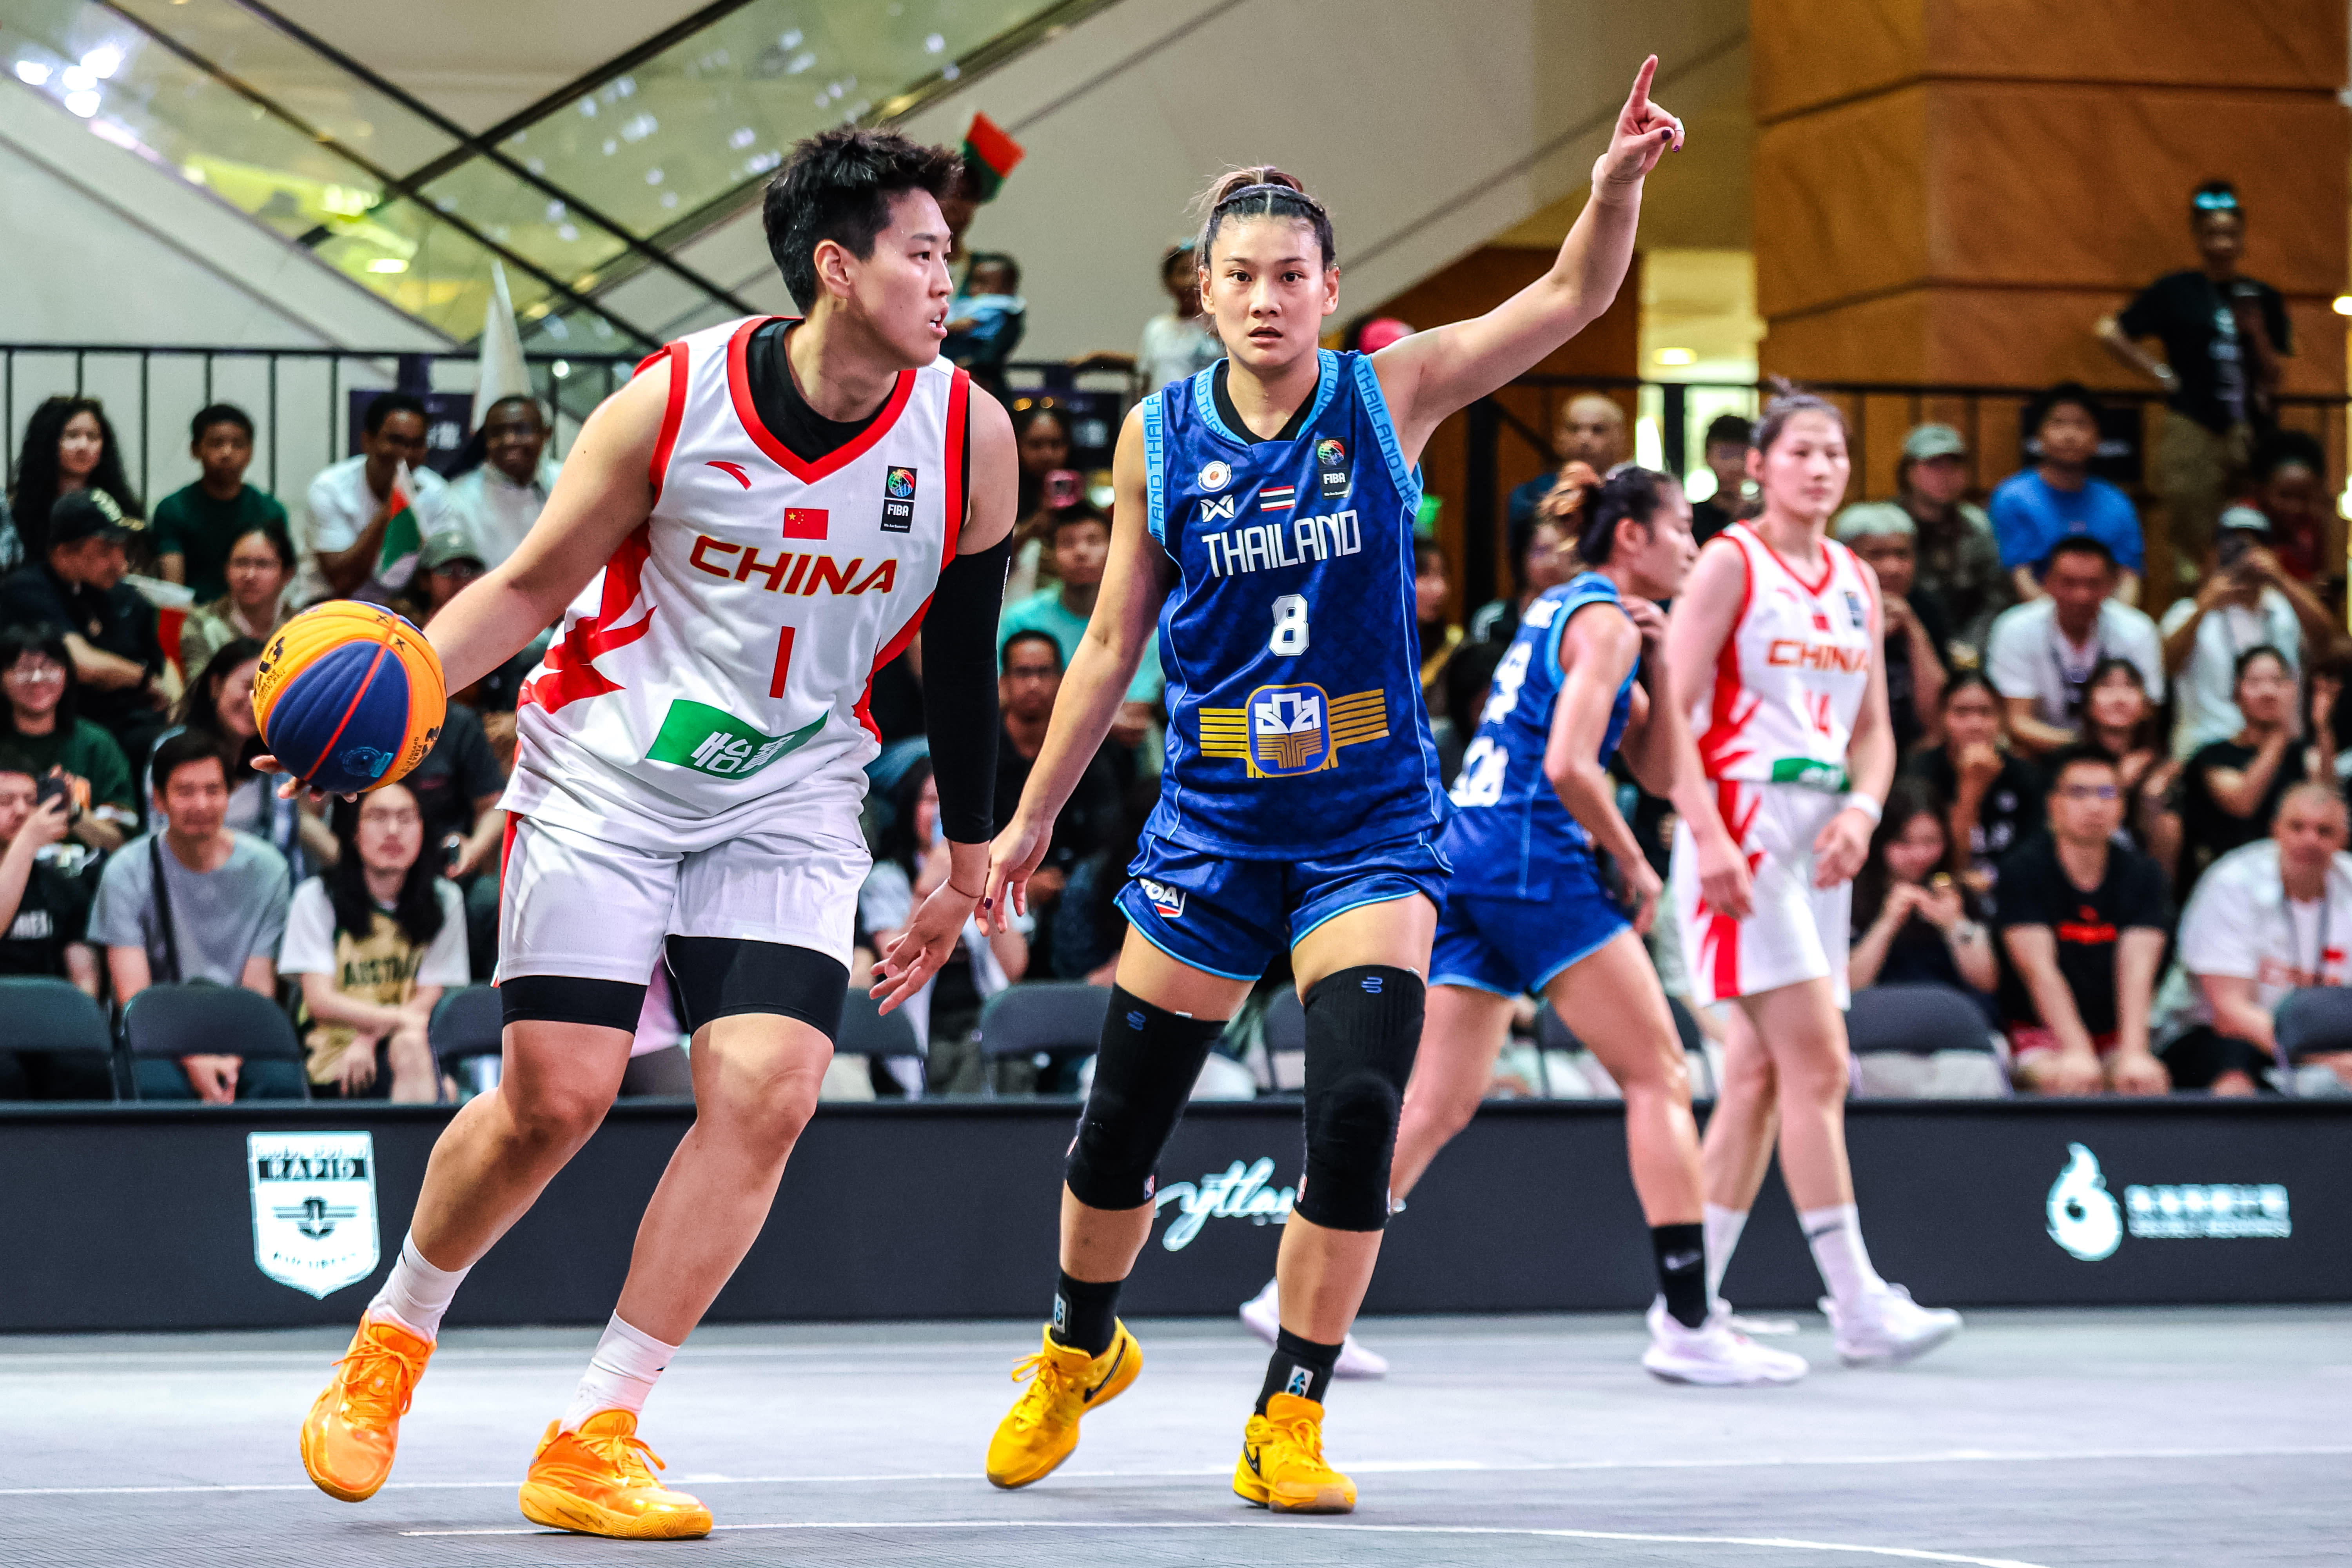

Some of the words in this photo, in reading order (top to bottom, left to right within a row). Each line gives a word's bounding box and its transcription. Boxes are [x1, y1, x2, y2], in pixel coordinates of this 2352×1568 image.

[1356, 363, 1402, 470] THAILAND
[887, 503, 909, 517] FIBA
[1323, 472, 1346, 485] FIBA
[689, 534, 898, 597] CHINA
[1201, 509, 1361, 578] THAILAND
[1268, 593, 1309, 657] 8
[769, 625, 795, 699] 1
